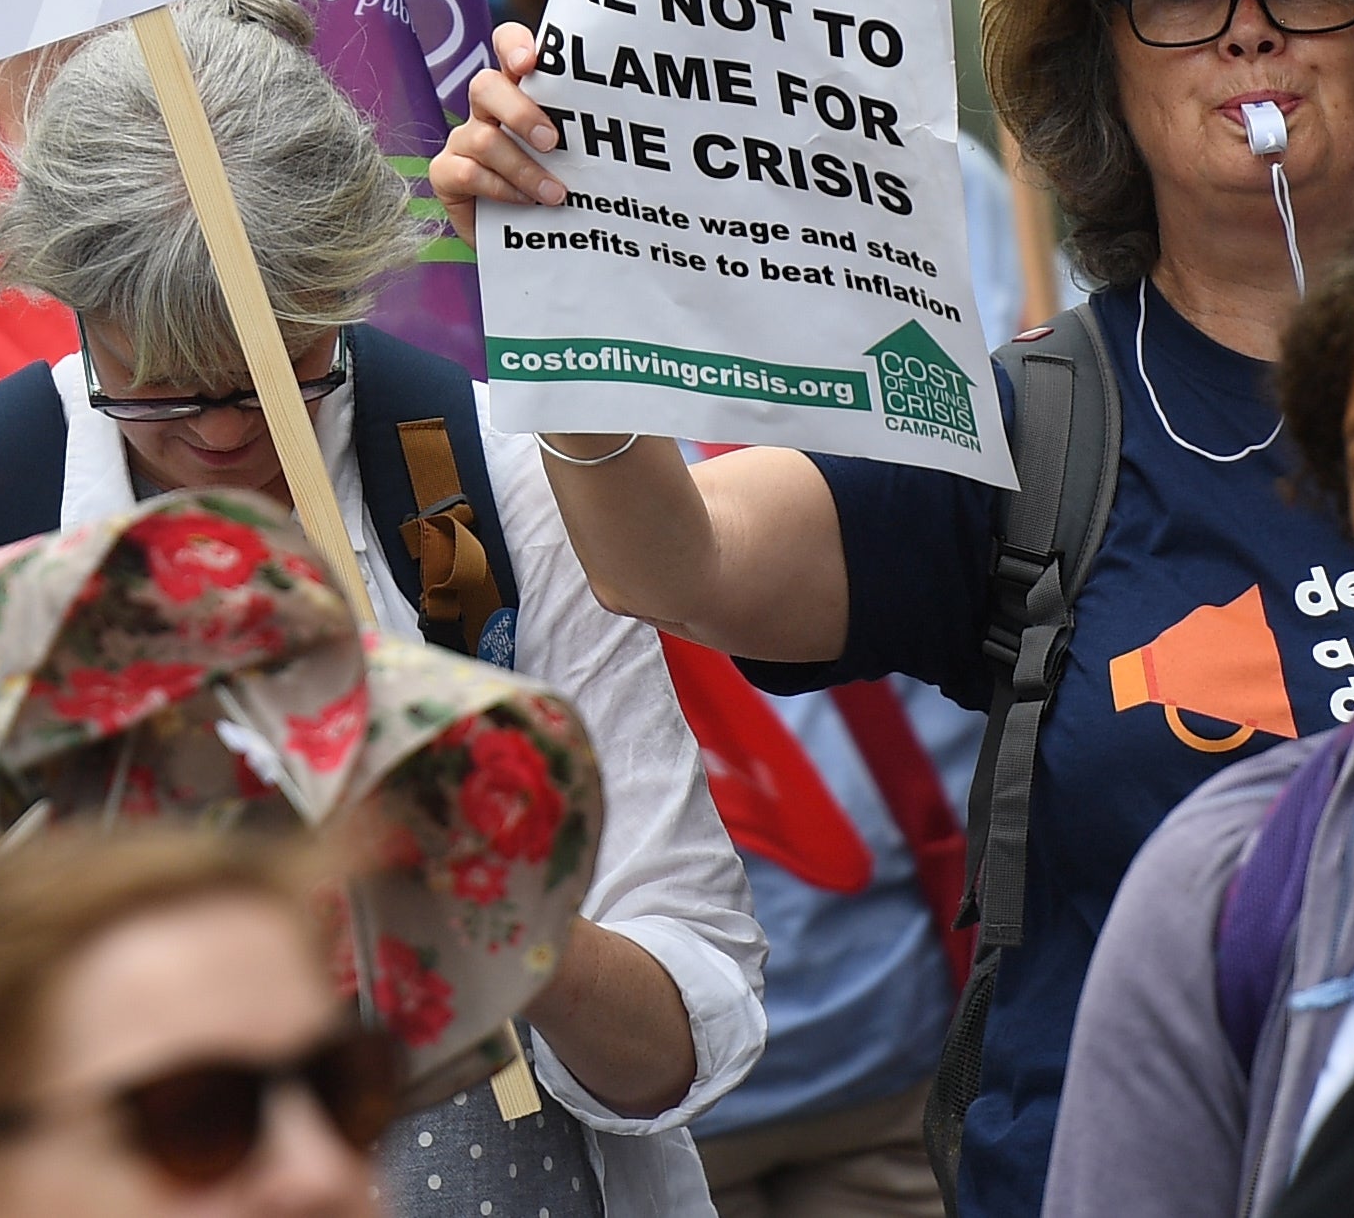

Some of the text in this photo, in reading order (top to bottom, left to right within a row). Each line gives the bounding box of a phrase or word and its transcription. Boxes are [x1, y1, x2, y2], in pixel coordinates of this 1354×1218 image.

[813, 7, 905, 69] TO
[535, 22, 906, 148] BLAME FOR
[537, 104, 914, 215] THE CRISIS
[535, 190, 938, 279] mediate wage and state
[502, 224, 963, 323] benefits rise to beat inflation
[500, 344, 855, 406] costoflivingcrisis.org
[880, 351, 963, 395] COST
[884, 375, 970, 412] OF LIVING
[884, 416, 983, 454] CAMPAIGN
[886, 391, 973, 432] CRISIS
